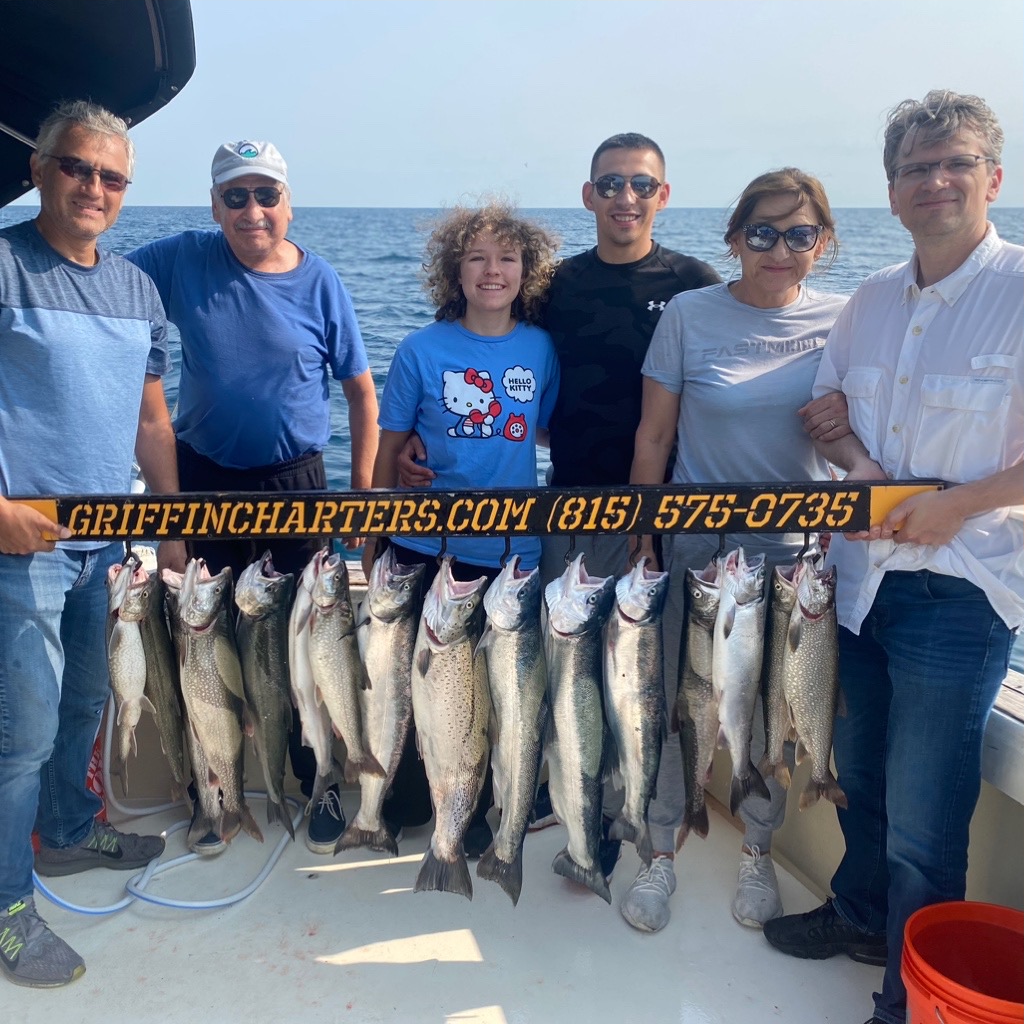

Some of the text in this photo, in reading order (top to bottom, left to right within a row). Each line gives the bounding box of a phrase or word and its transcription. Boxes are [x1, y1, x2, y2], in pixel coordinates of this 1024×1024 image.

[68, 491, 860, 536] GRIFFINCHARTERS.COM (815) 575-0735
